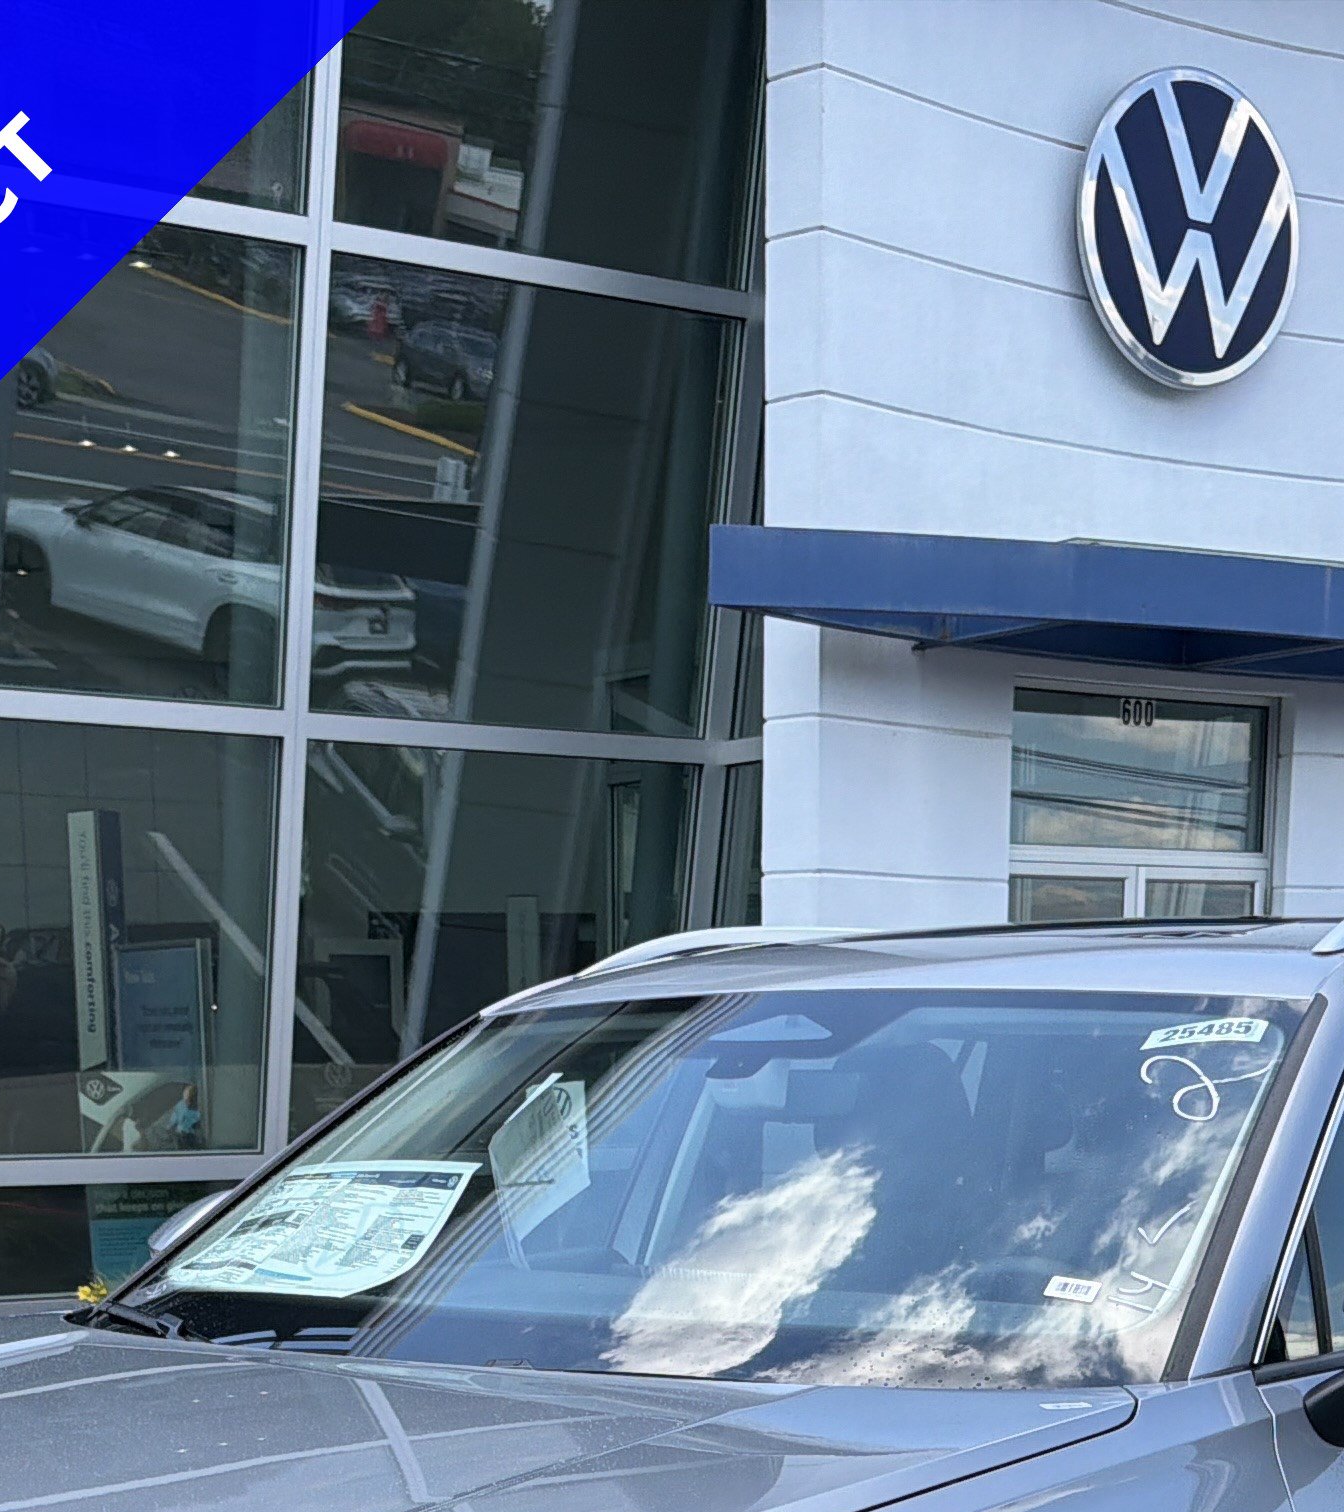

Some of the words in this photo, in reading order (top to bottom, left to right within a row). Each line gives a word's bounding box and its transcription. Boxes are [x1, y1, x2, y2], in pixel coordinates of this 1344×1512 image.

[1086, 76, 1297, 378] VW
[1122, 699, 1154, 727] 600
[1160, 1020, 1253, 1043] 25485
